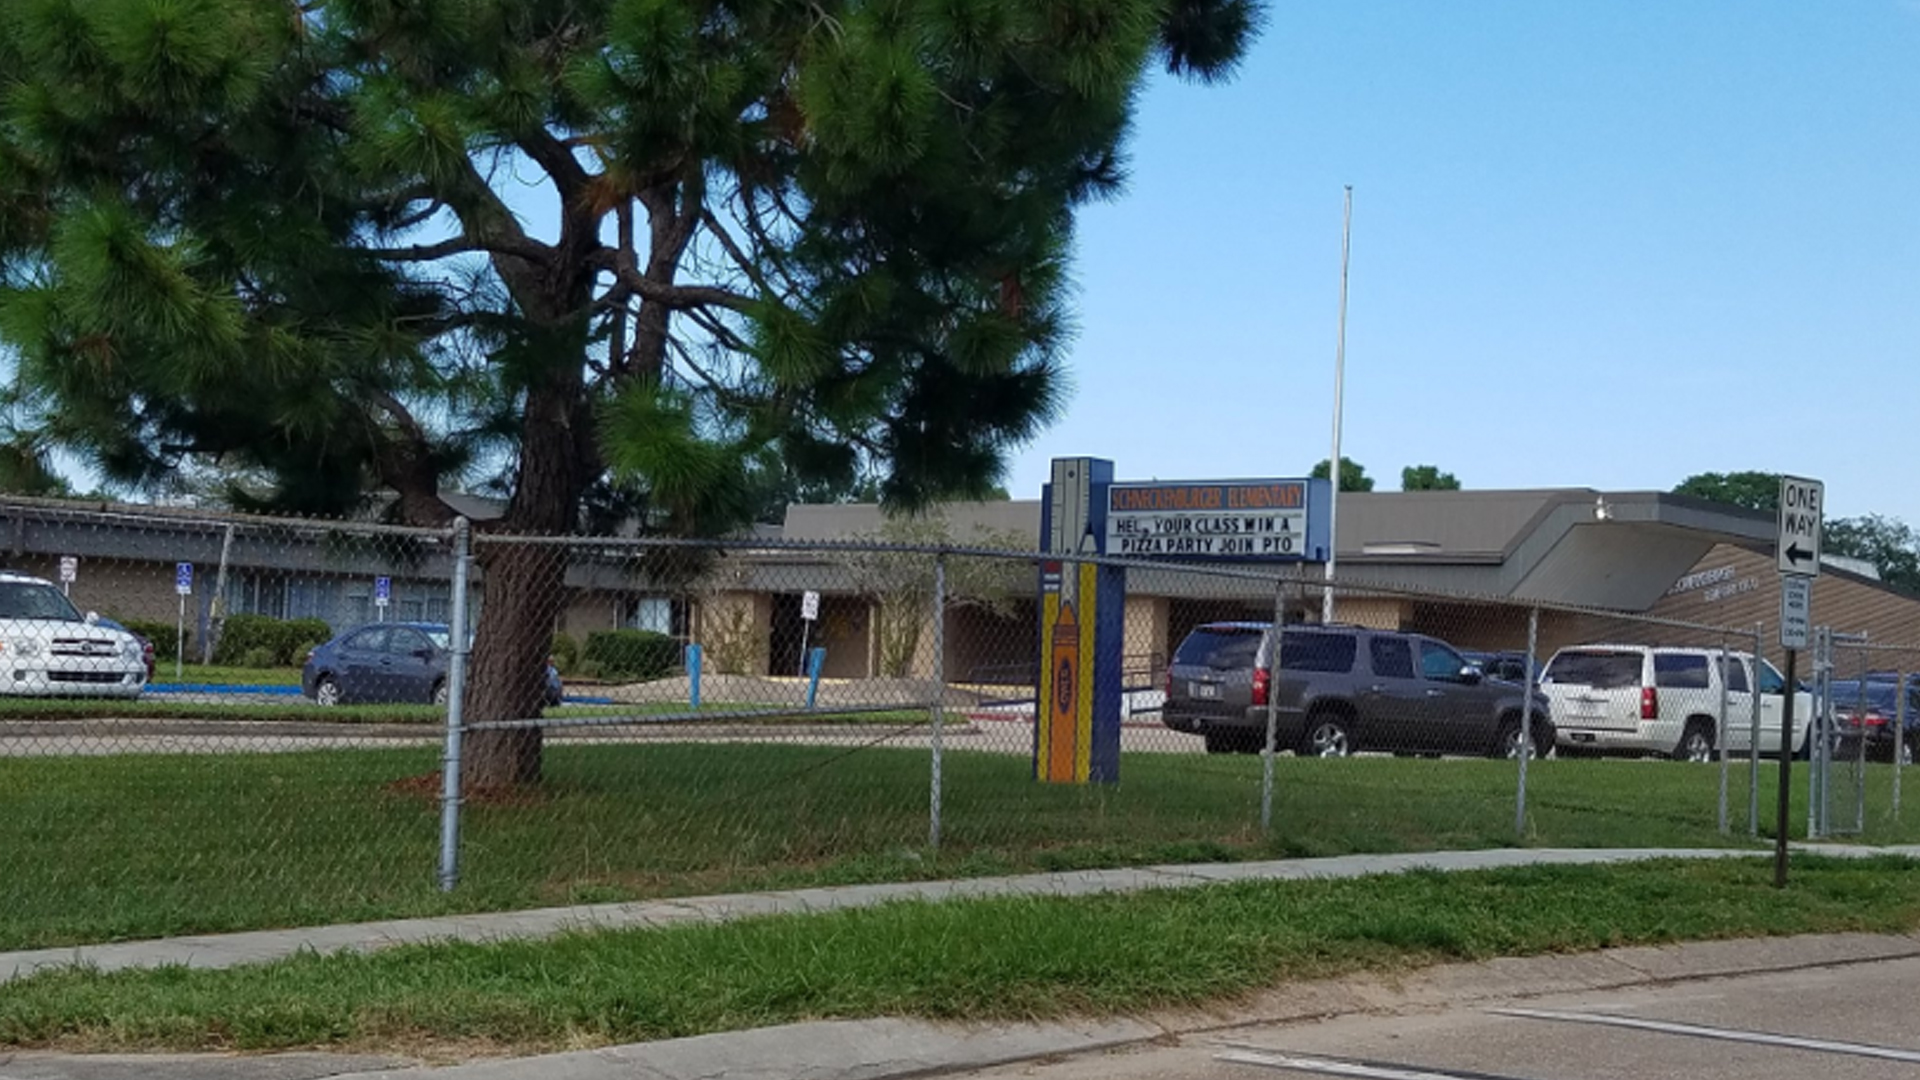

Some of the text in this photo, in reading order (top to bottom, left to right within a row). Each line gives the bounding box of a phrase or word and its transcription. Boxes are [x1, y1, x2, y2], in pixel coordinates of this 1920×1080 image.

[1786, 485, 1817, 511] ONE
[1154, 517, 1192, 534] YOUR
[1195, 517, 1239, 533] CLASS
[1244, 517, 1274, 532] WIN
[1281, 517, 1290, 532] A
[1786, 512, 1816, 537] WAY
[1121, 537, 1292, 552] PIZZA PARTY JOIN PTO
